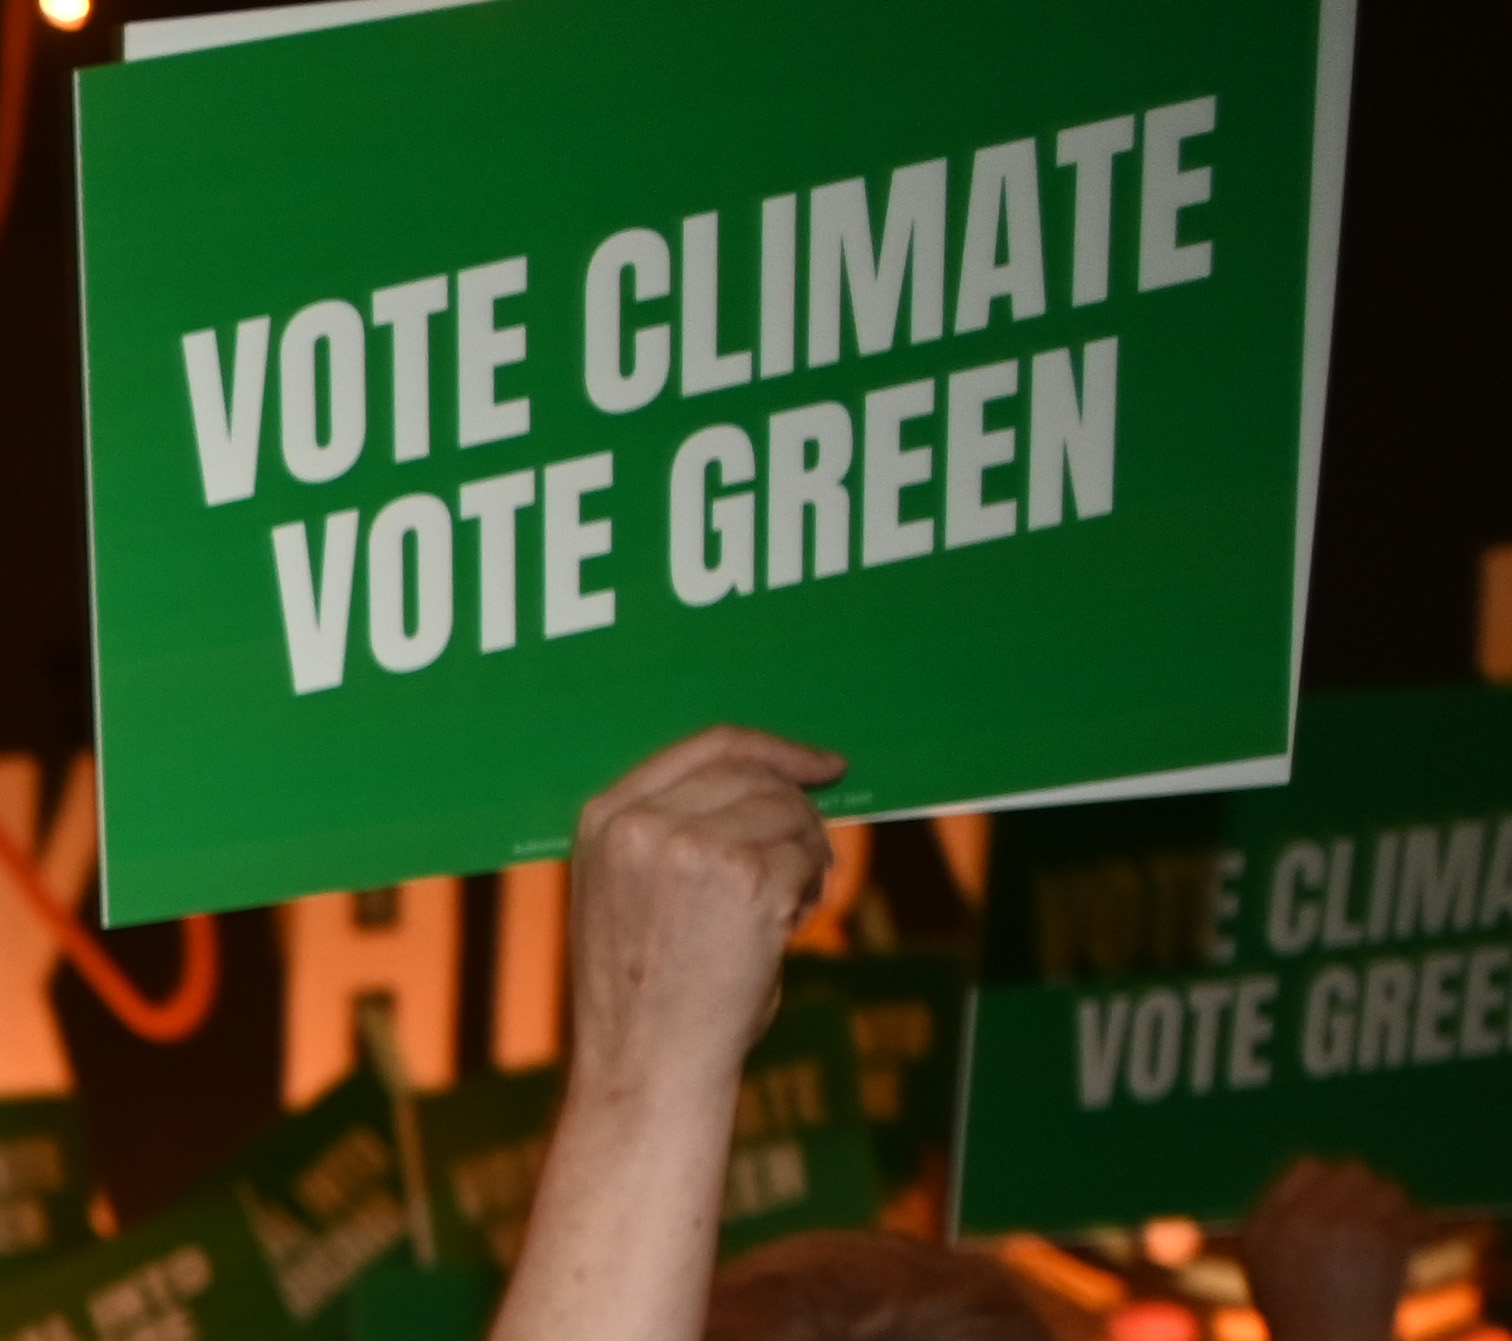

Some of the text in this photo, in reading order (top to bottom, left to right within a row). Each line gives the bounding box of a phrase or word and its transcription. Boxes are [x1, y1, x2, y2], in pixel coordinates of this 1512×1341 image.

[182, 95, 1217, 507] VOTE CLIMATE
[271, 337, 1118, 697] VOTE GREEN
[1076, 973, 1280, 1112] VOTE
[1299, 944, 1512, 1080] GREE
